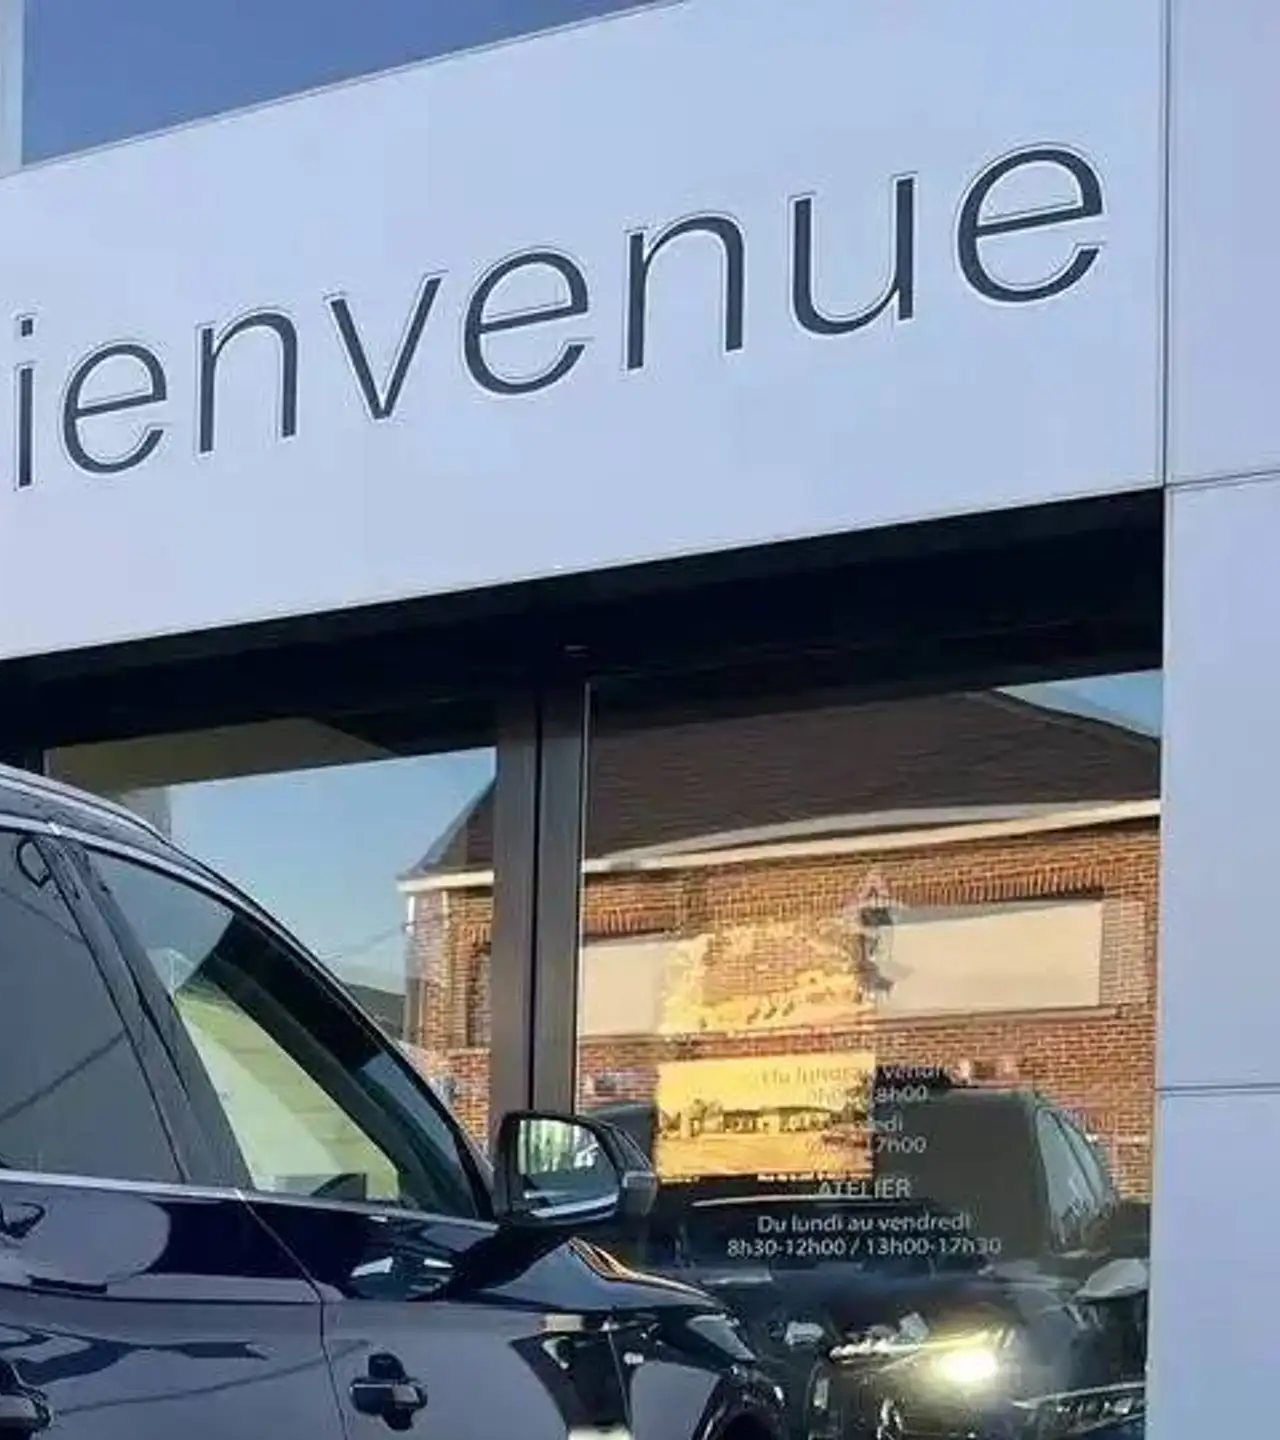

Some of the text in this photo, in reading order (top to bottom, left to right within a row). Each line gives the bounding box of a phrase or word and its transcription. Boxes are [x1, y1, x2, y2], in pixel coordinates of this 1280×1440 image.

[818, 1178, 911, 1199] ATELIER
[757, 1211, 971, 1233] Du lundi au vendredi
[727, 1237, 846, 1258] 8h30-12h00
[866, 1236, 1002, 1256] 13h00-17h30
